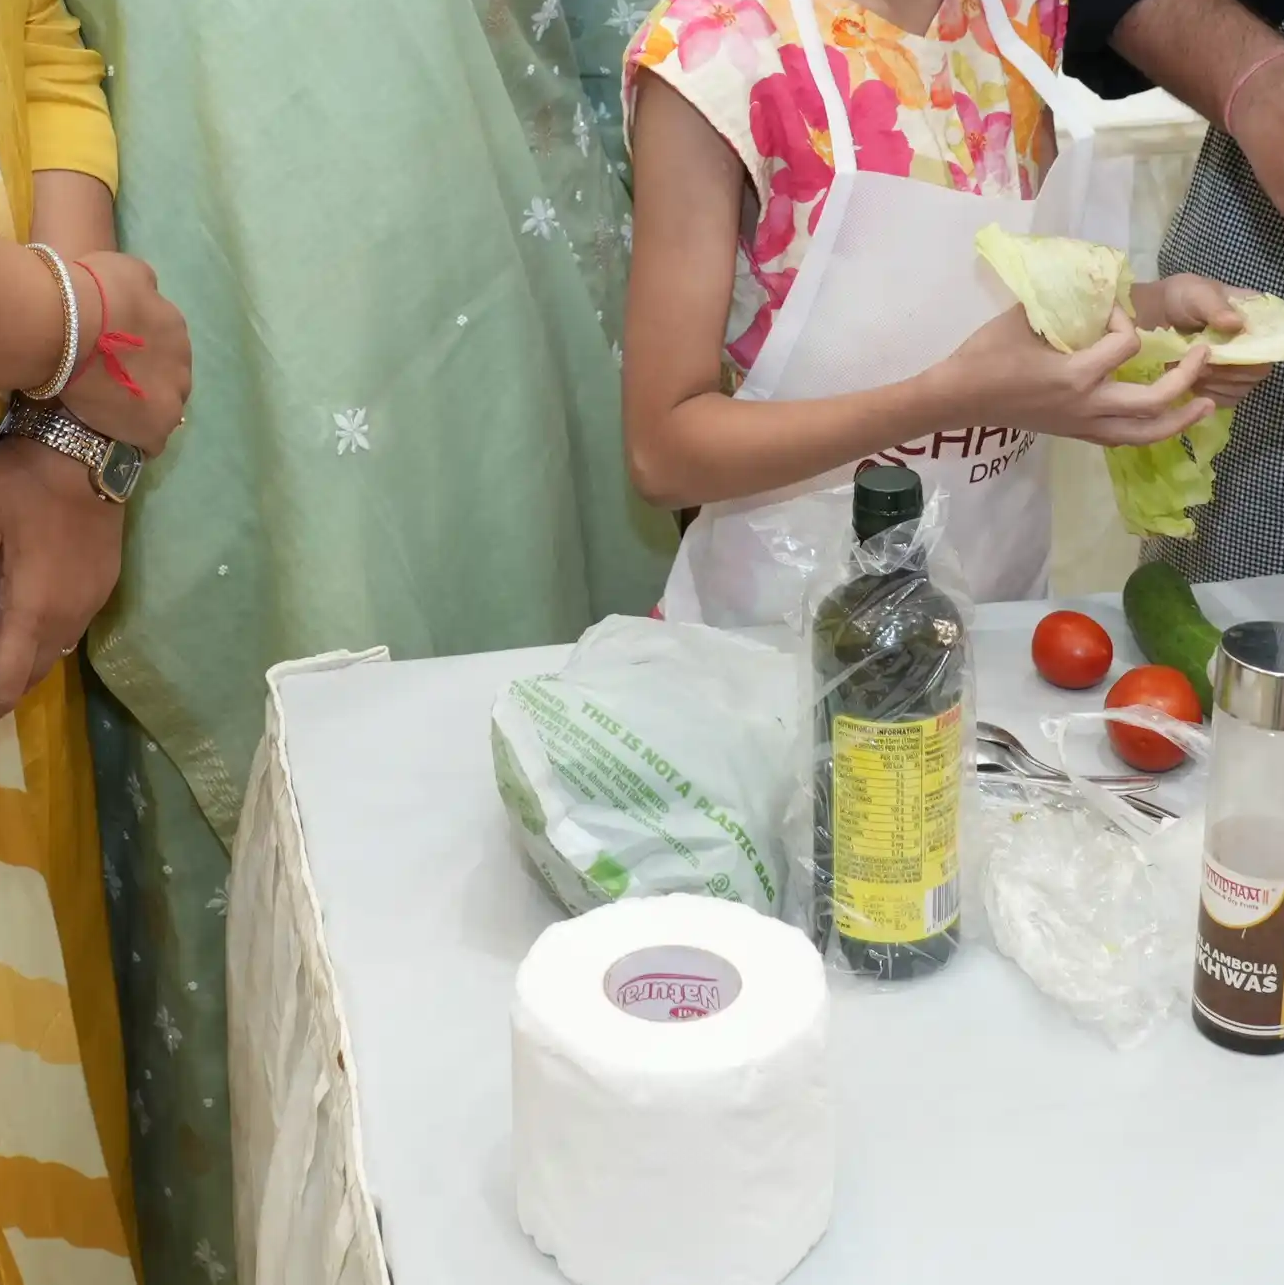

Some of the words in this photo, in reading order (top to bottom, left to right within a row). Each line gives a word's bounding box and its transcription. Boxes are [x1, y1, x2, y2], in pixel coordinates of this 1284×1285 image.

[969, 451, 1014, 484] DRY
[876, 726, 920, 736] INFORMATION
[581, 701, 623, 738] THIS
[619, 730, 643, 752] IS
[640, 746, 682, 784] NOT
[675, 780, 692, 799] A
[694, 796, 757, 862] PLASTIC
[755, 860, 776, 904] BAG
[1211, 948, 1278, 975] AMBOLIA
[617, 980, 721, 1011] Natural
